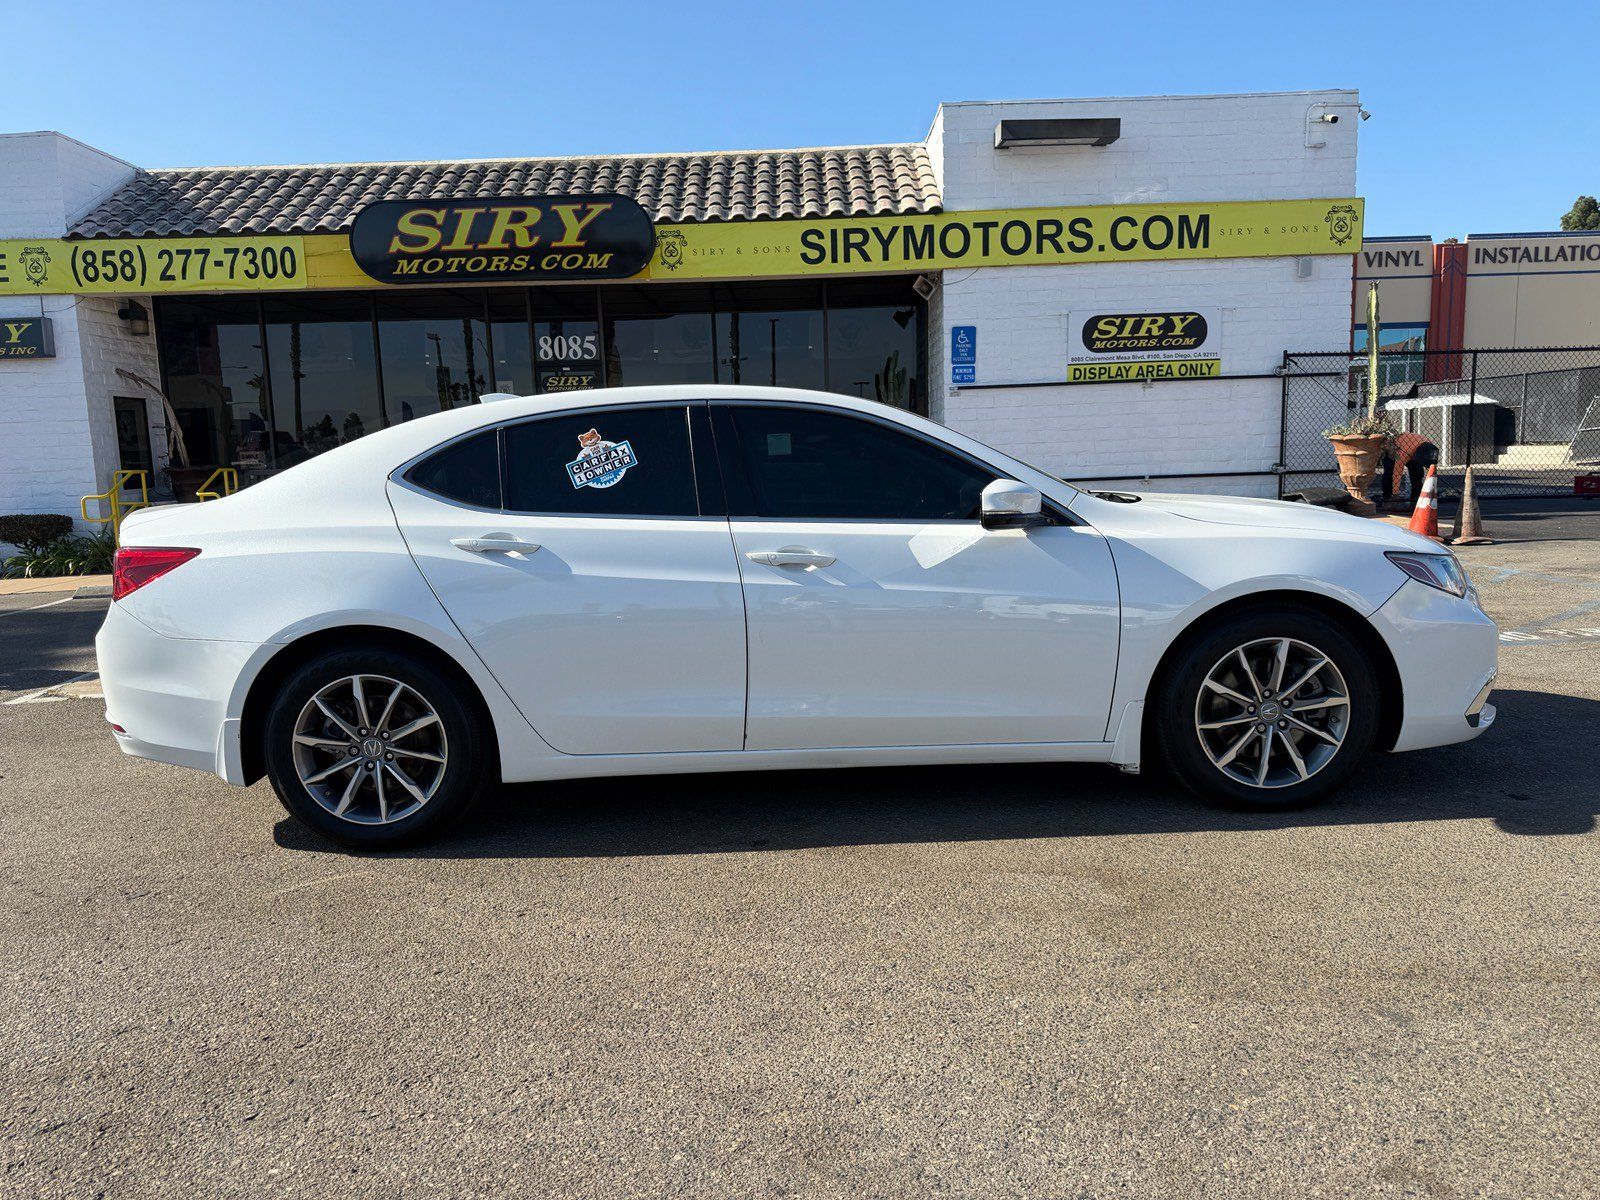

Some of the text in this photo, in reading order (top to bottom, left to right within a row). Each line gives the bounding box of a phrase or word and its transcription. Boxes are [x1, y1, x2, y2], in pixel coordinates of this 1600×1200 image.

[388, 202, 613, 254] SIRY
[1219, 227, 1253, 236] SIRY
[1281, 225, 1319, 234] SONS
[692, 247, 726, 256] SIRY
[753, 245, 791, 254] SONS
[799, 214, 1211, 265] SIRYMOTORS.COM
[392, 253, 614, 275] MOTORS.COM
[1363, 250, 1424, 268] VINYL
[1474, 244, 1600, 264] INSTALLATIO
[71, 245, 297, 287] (858) 277-7300
[1091, 315, 1199, 339] SIRY
[539, 335, 597, 360] 8085
[1092, 338, 1196, 348] MOTORS.COM
[546, 375, 594, 387] SIRY
[1072, 363, 1215, 380] DISPLAY AREA ONLY
[572, 447, 627, 473] CARFAX
[586, 456, 631, 479] OWNER
